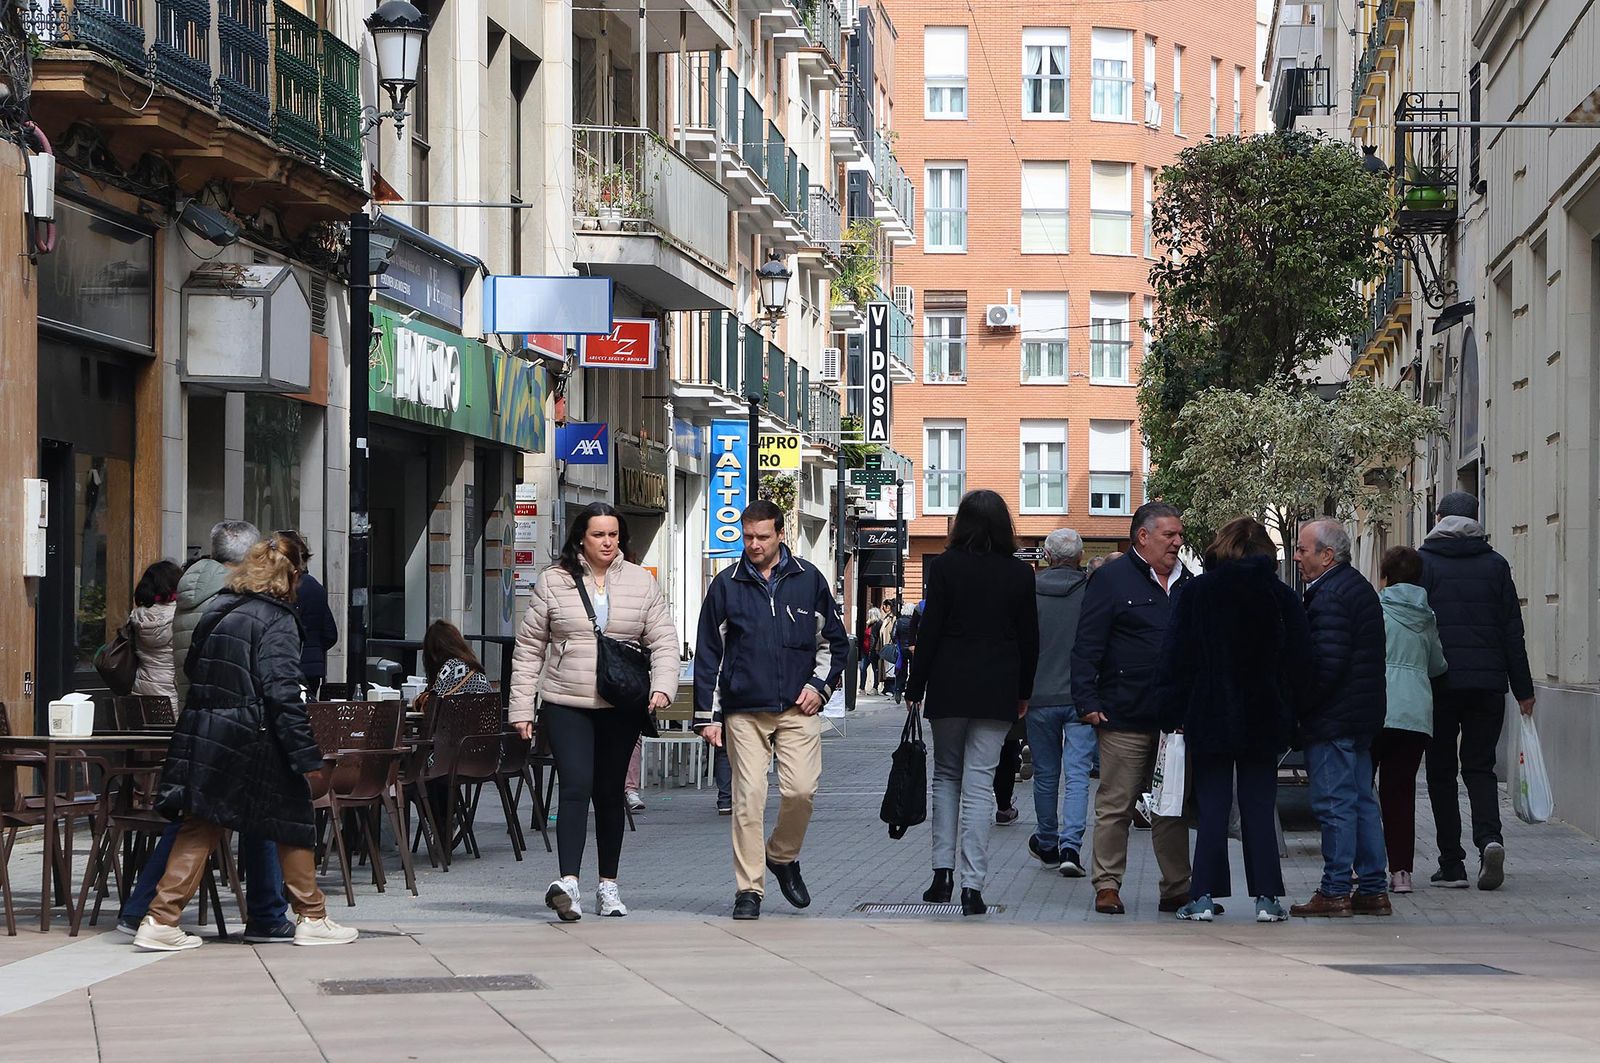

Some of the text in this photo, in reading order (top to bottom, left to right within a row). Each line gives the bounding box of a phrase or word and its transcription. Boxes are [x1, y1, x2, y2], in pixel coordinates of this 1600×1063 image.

[871, 306, 886, 439] VIDOSA
[571, 439, 604, 455] AXA
[715, 435, 742, 543] TATTOO
